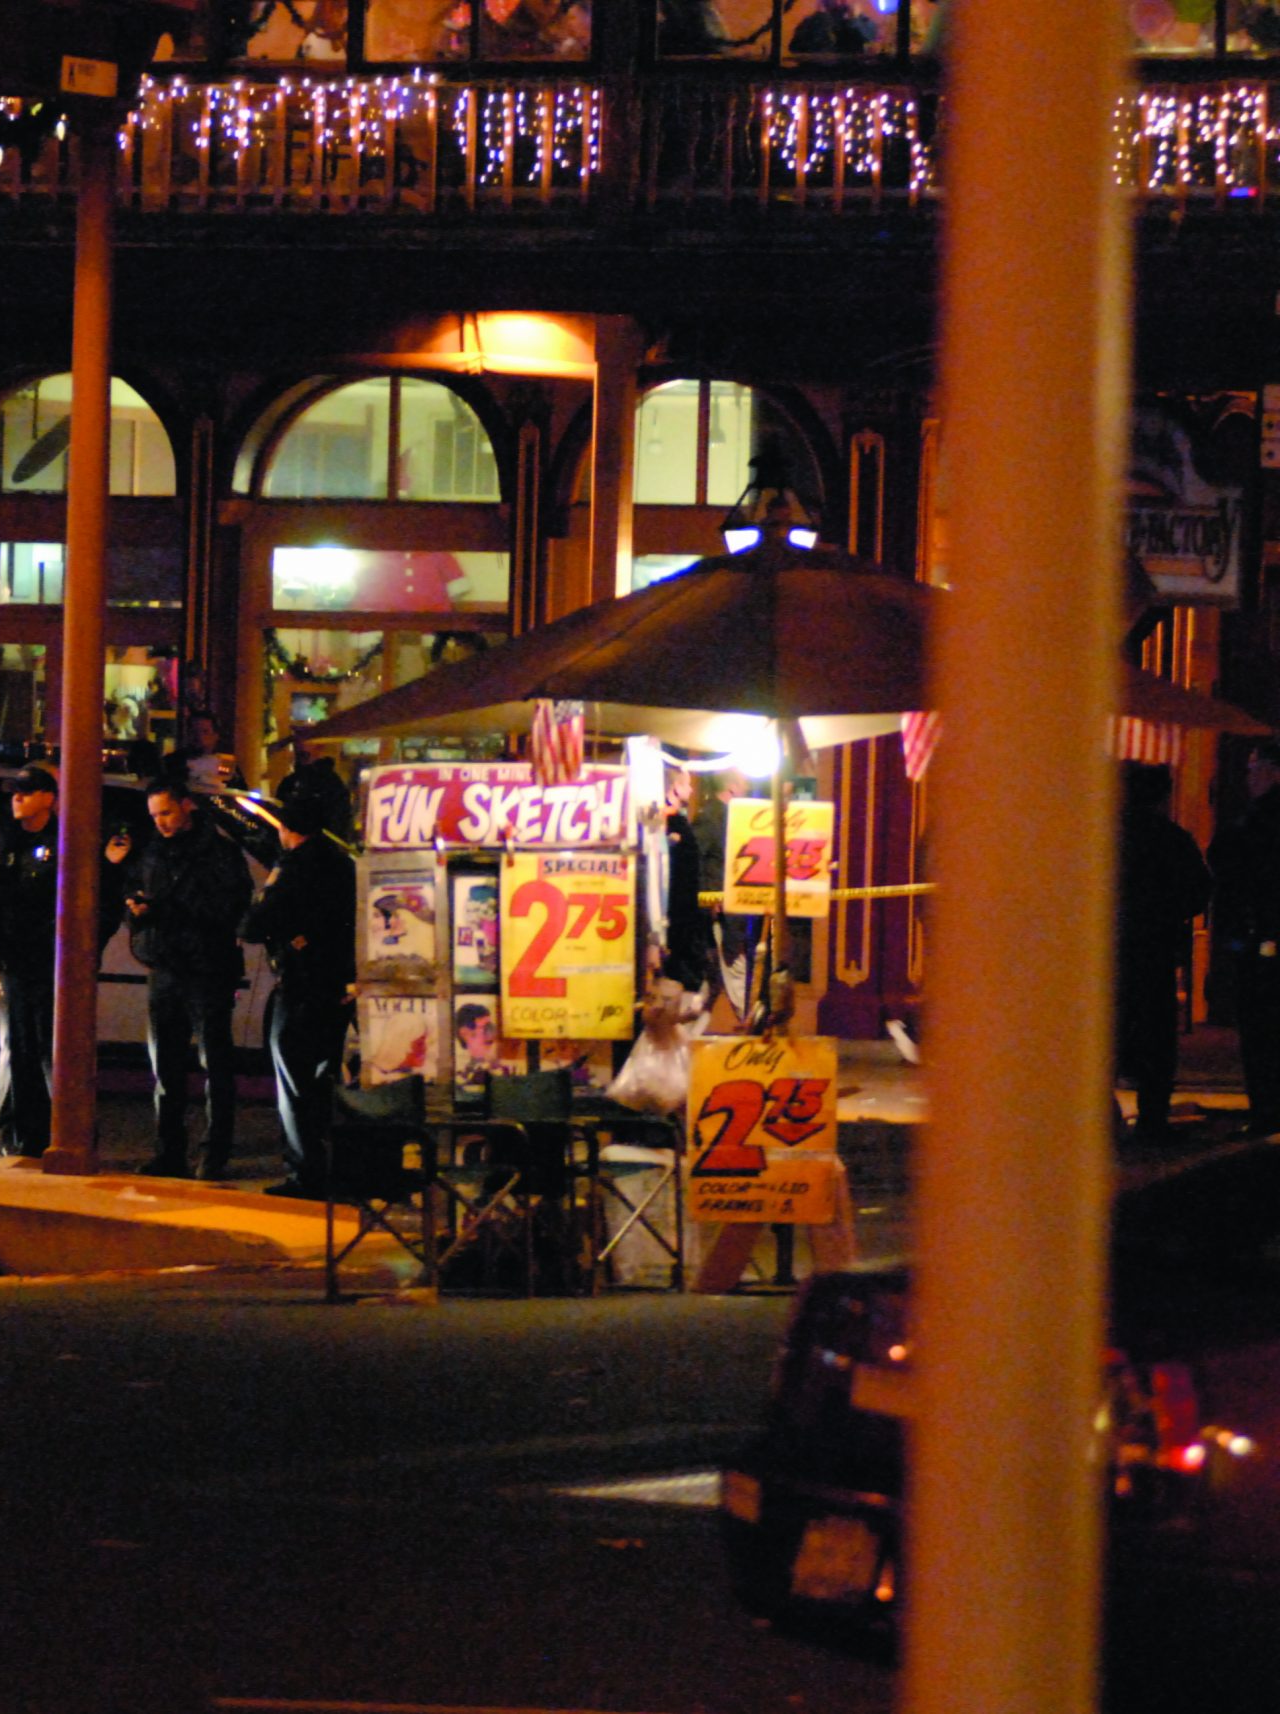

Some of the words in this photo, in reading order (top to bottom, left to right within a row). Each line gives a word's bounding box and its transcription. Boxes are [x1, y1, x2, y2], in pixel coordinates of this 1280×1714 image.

[371, 782, 446, 844] FUN
[458, 776, 627, 844] SKETCH
[724, 1040, 786, 1074] Only
